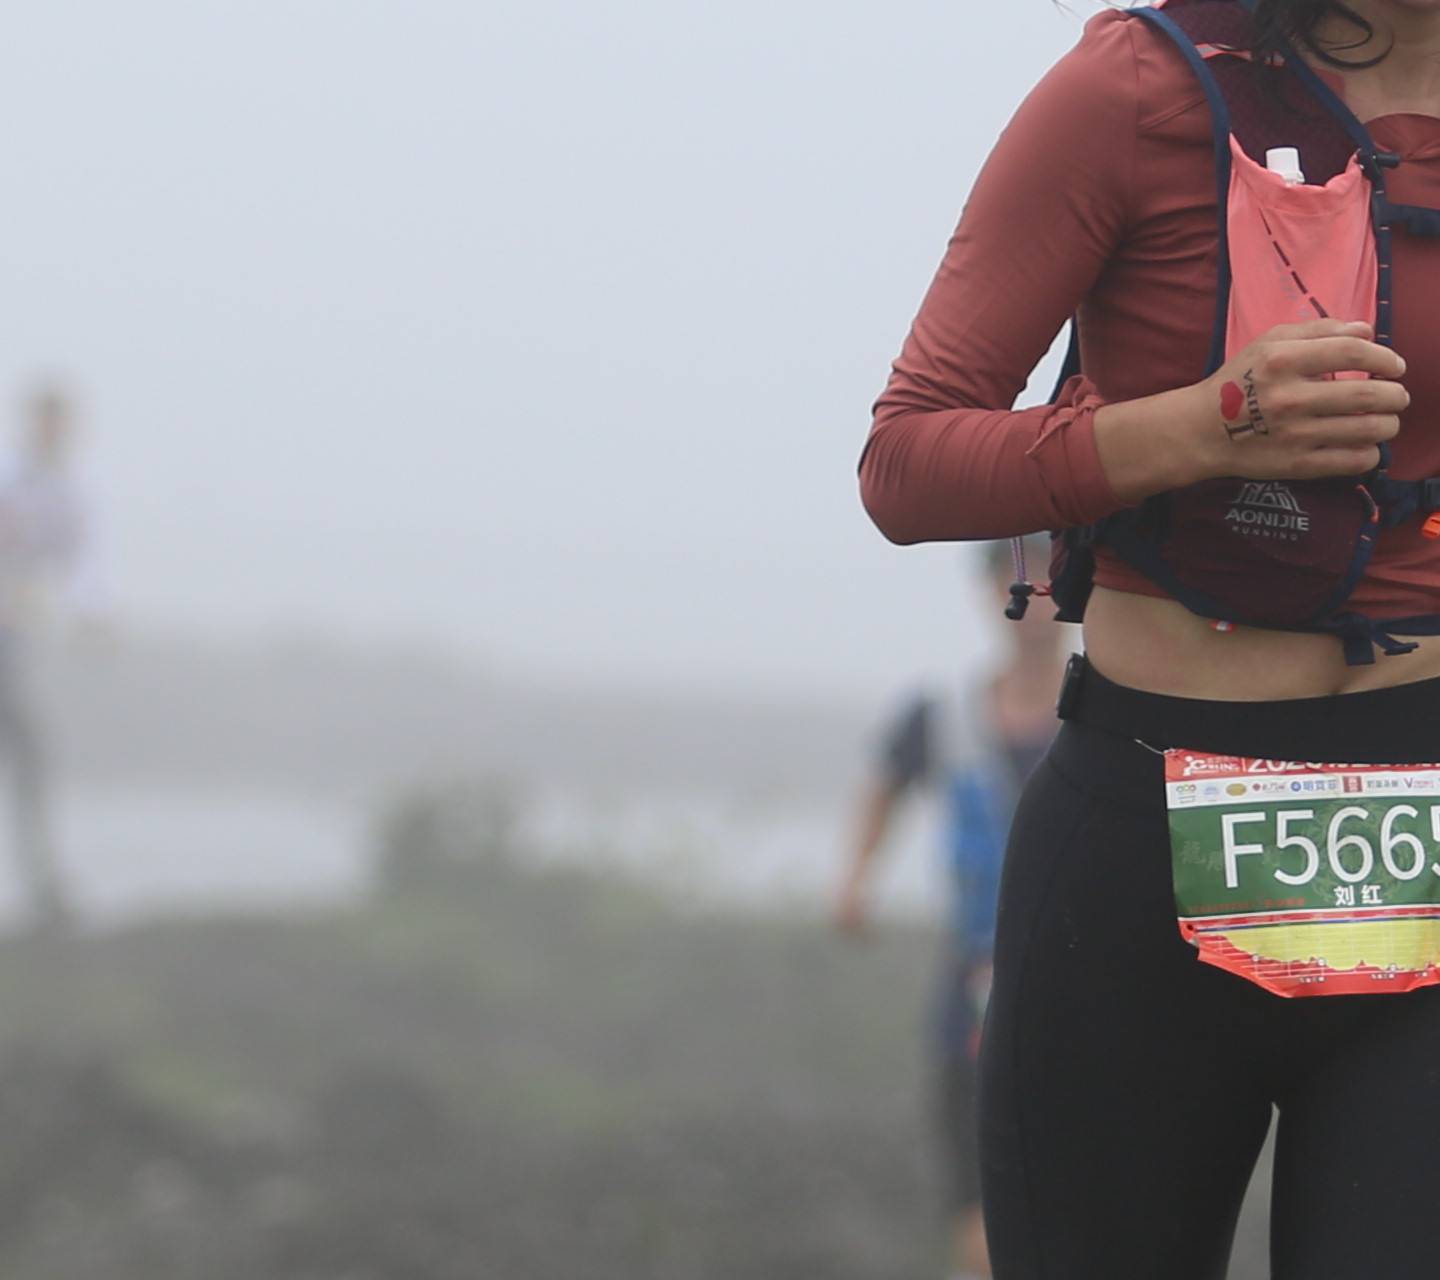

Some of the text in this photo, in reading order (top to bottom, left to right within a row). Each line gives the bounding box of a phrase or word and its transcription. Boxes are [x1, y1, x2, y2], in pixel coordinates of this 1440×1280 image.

[1243, 368, 1269, 437] CHINA
[1225, 508, 1310, 531] AONIJIE
[1231, 526, 1299, 541] RUNNING
